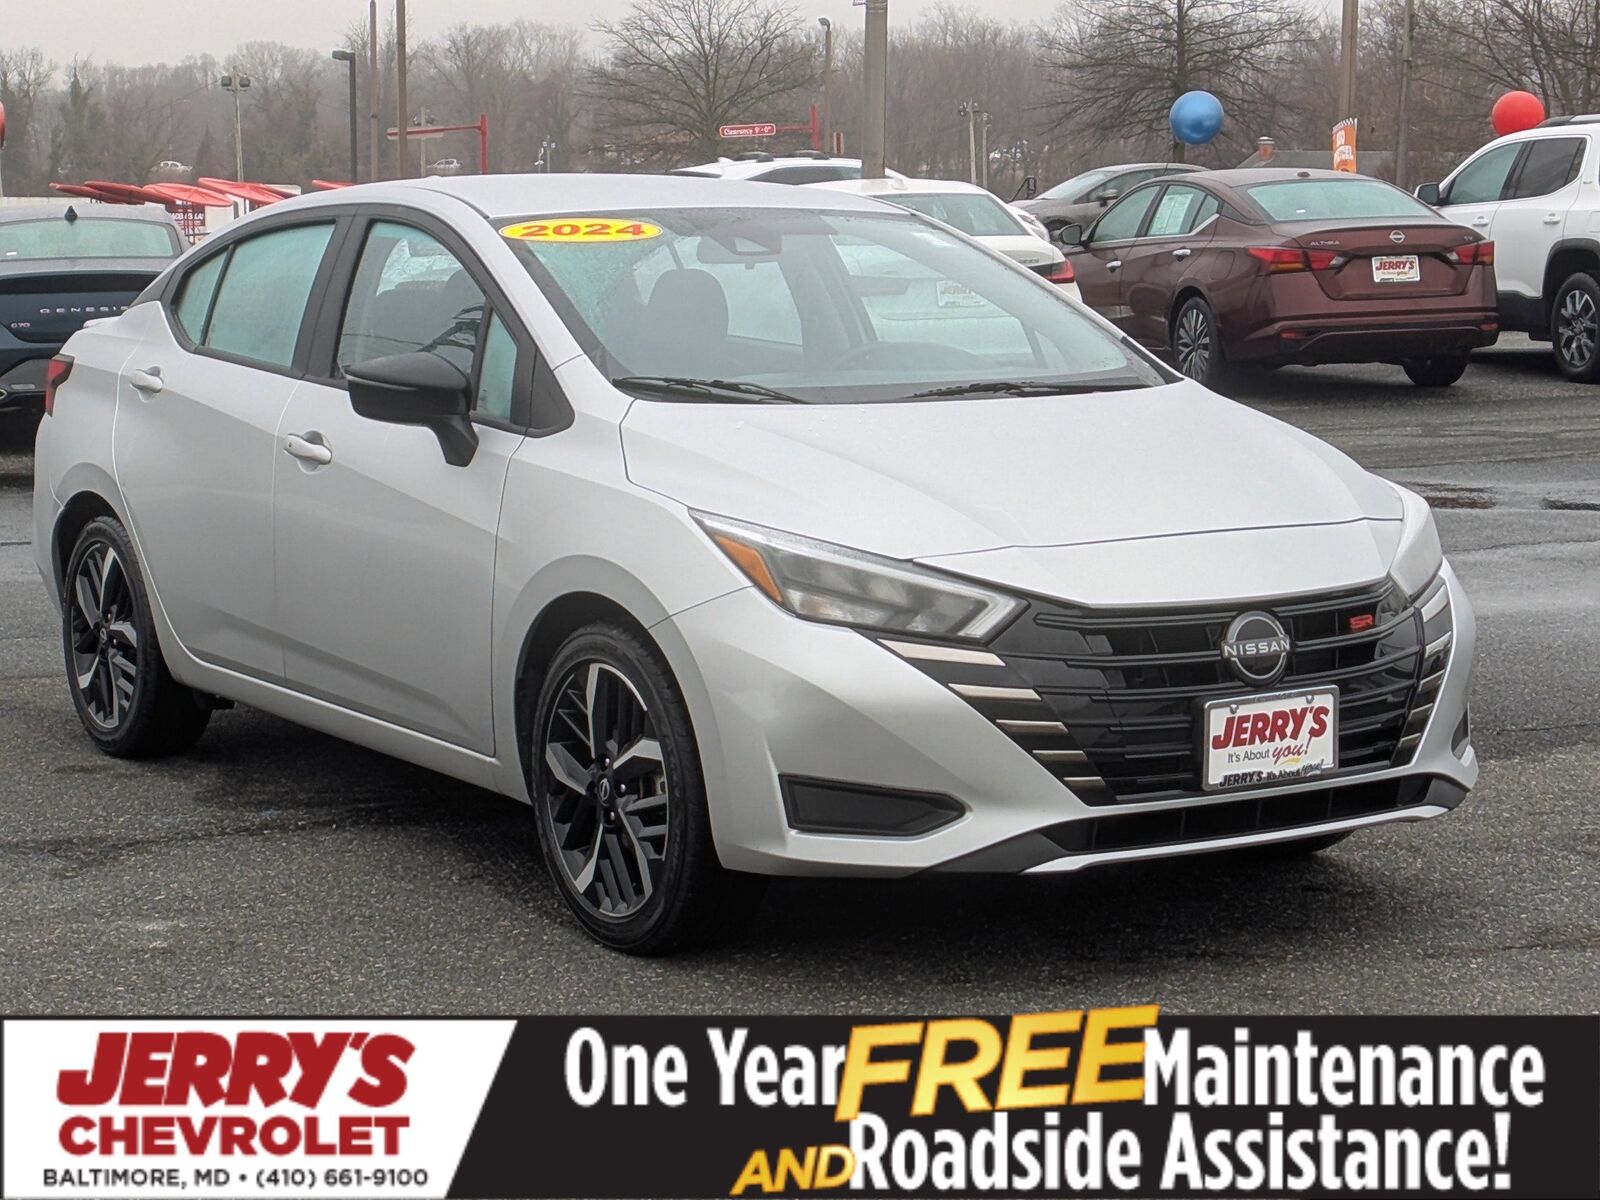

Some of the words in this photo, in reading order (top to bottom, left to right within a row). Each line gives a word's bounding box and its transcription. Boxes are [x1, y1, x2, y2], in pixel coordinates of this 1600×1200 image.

[520, 223, 646, 237] 2024
[1375, 260, 1415, 271] JERRY'S
[1349, 614, 1373, 630] SR
[1223, 639, 1290, 657] NISSAN
[1211, 705, 1330, 750] JERRY'S
[1227, 752, 1241, 764] It's
[1242, 749, 1270, 762] About
[1272, 734, 1313, 766] you!
[1219, 770, 1264, 788] JERRY'S
